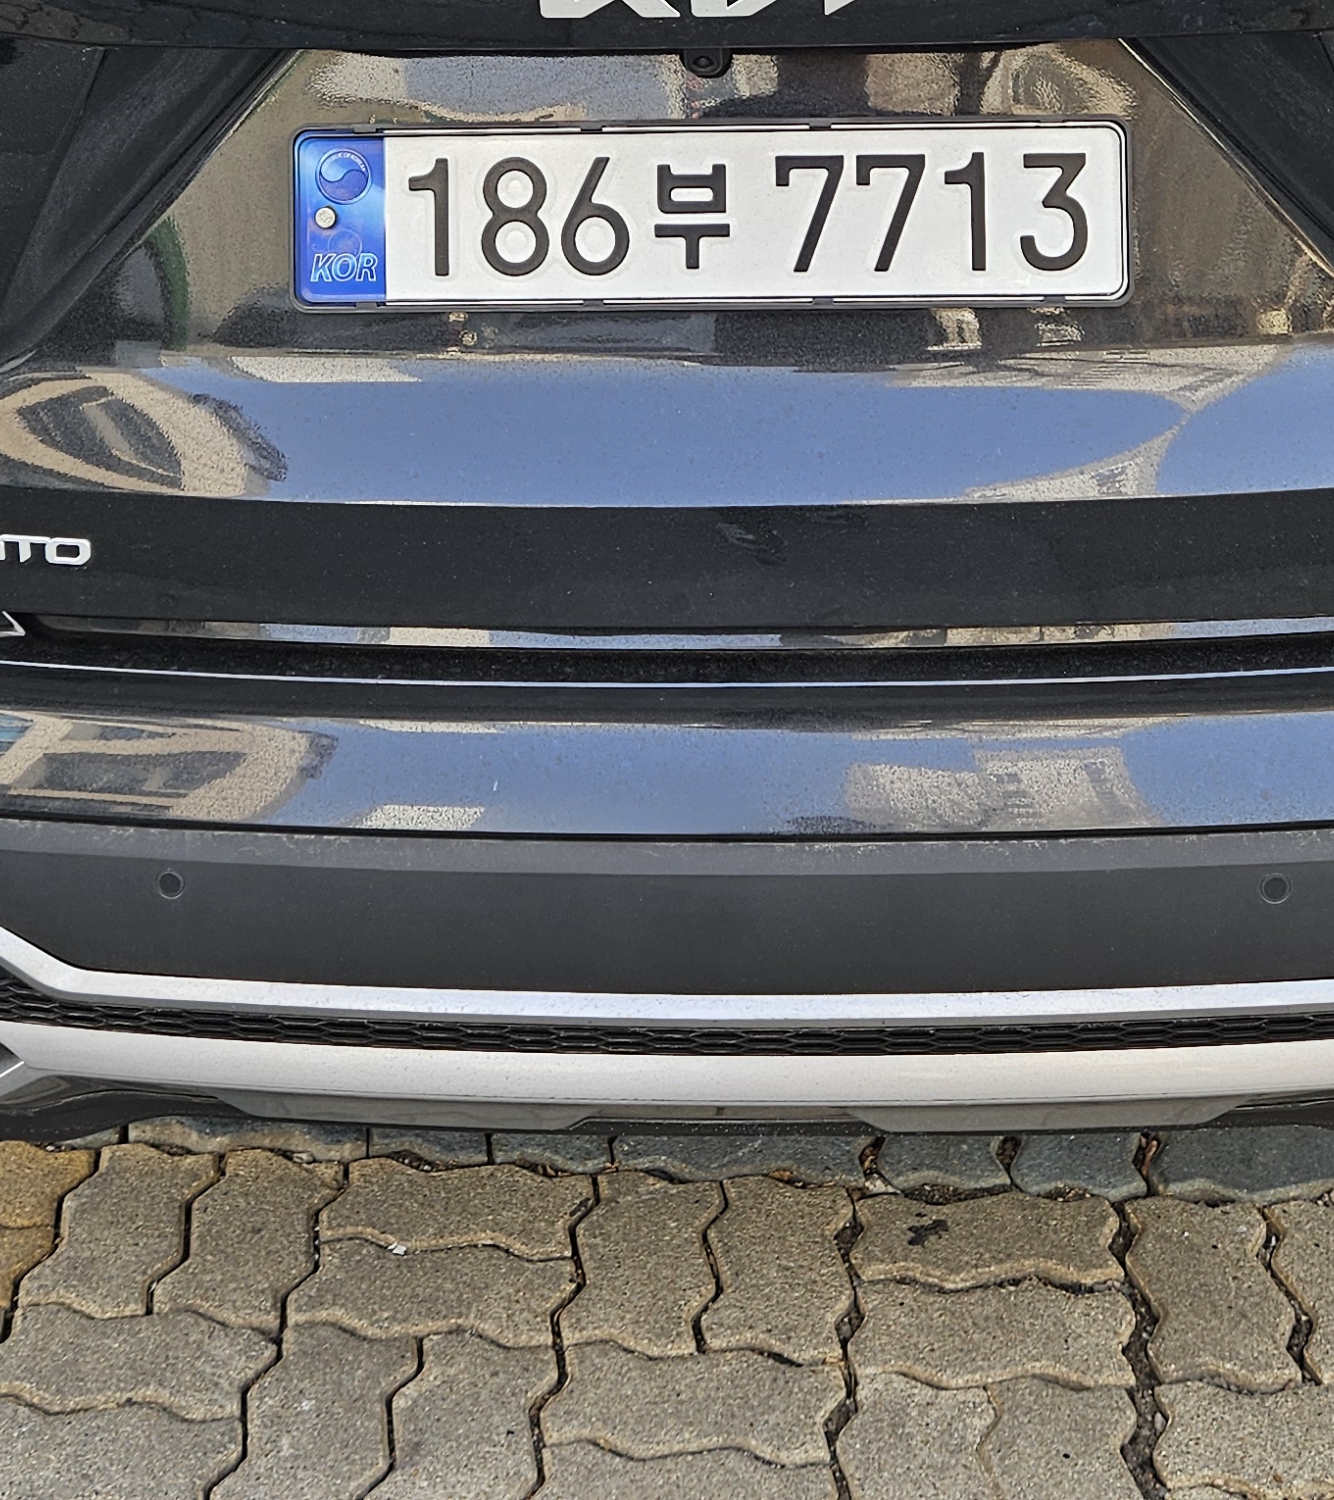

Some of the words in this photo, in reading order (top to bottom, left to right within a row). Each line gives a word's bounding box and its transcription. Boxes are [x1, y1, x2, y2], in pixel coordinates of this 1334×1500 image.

[407, 155, 731, 278] 186부
[774, 150, 1089, 274] 7713
[310, 252, 379, 283] KOR
